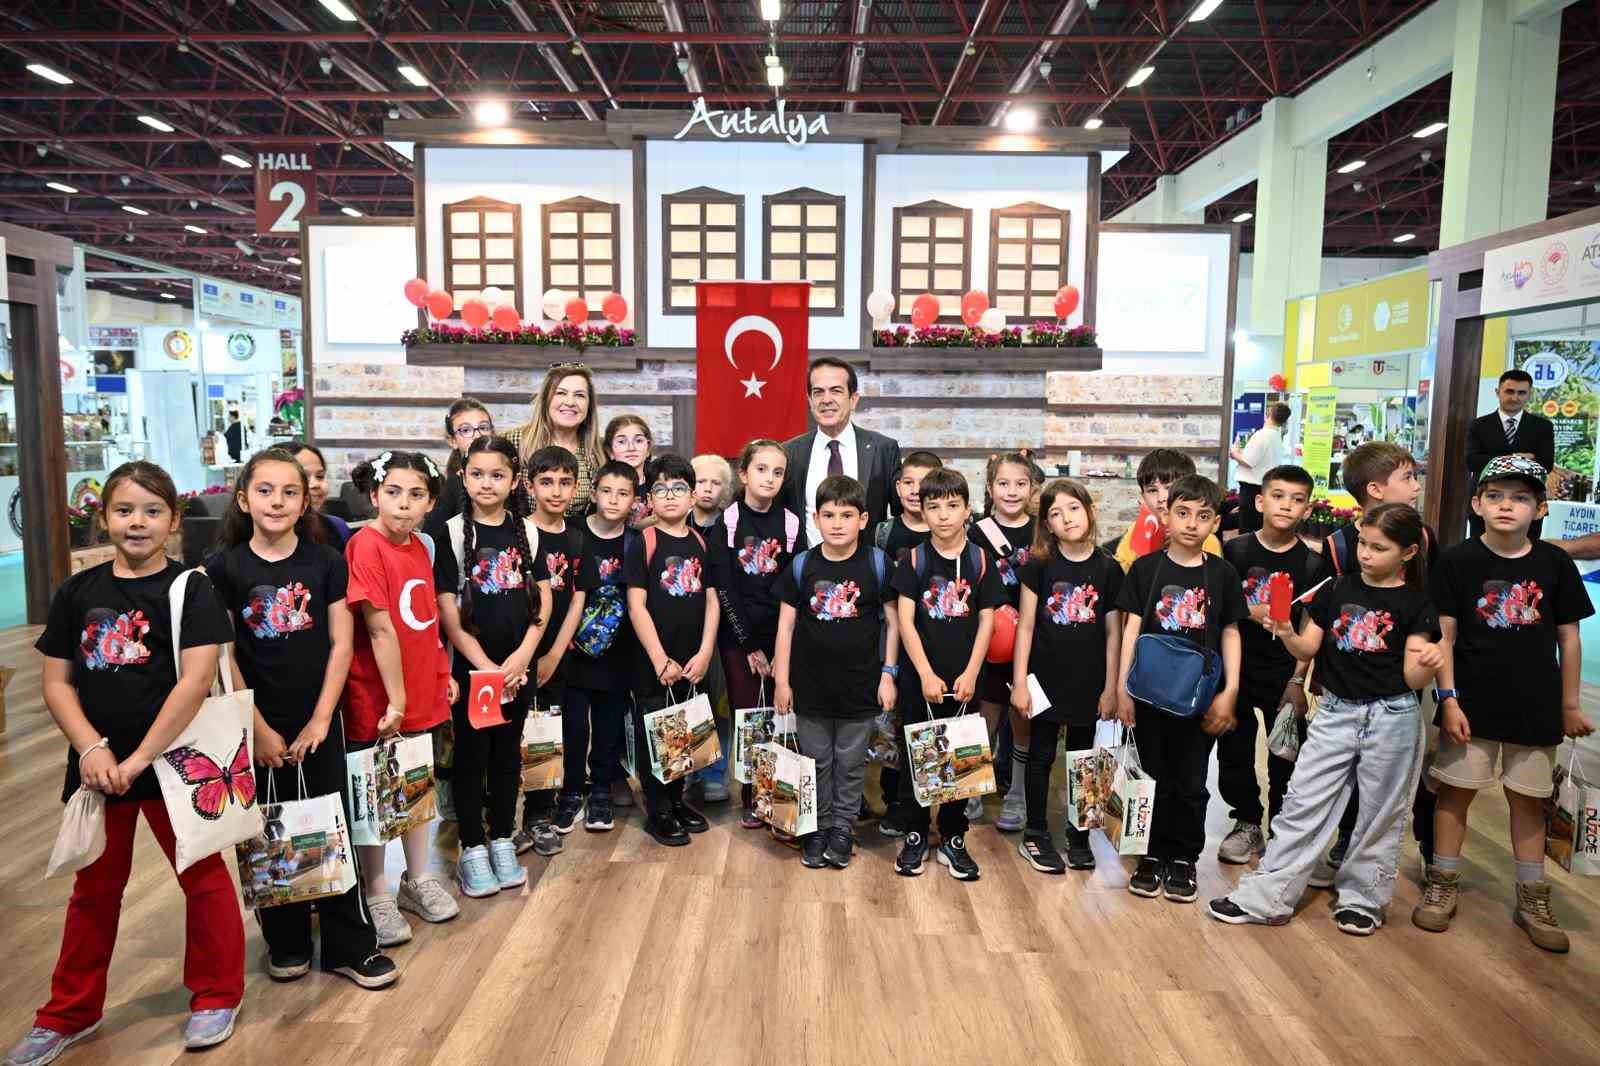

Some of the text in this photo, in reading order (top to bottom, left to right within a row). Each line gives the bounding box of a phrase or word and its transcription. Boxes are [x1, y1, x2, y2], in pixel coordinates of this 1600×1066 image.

[673, 96, 830, 145] Antalya
[258, 153, 312, 171] HALL
[269, 181, 306, 232] 2
[1569, 507, 1596, 520] AYDIN
